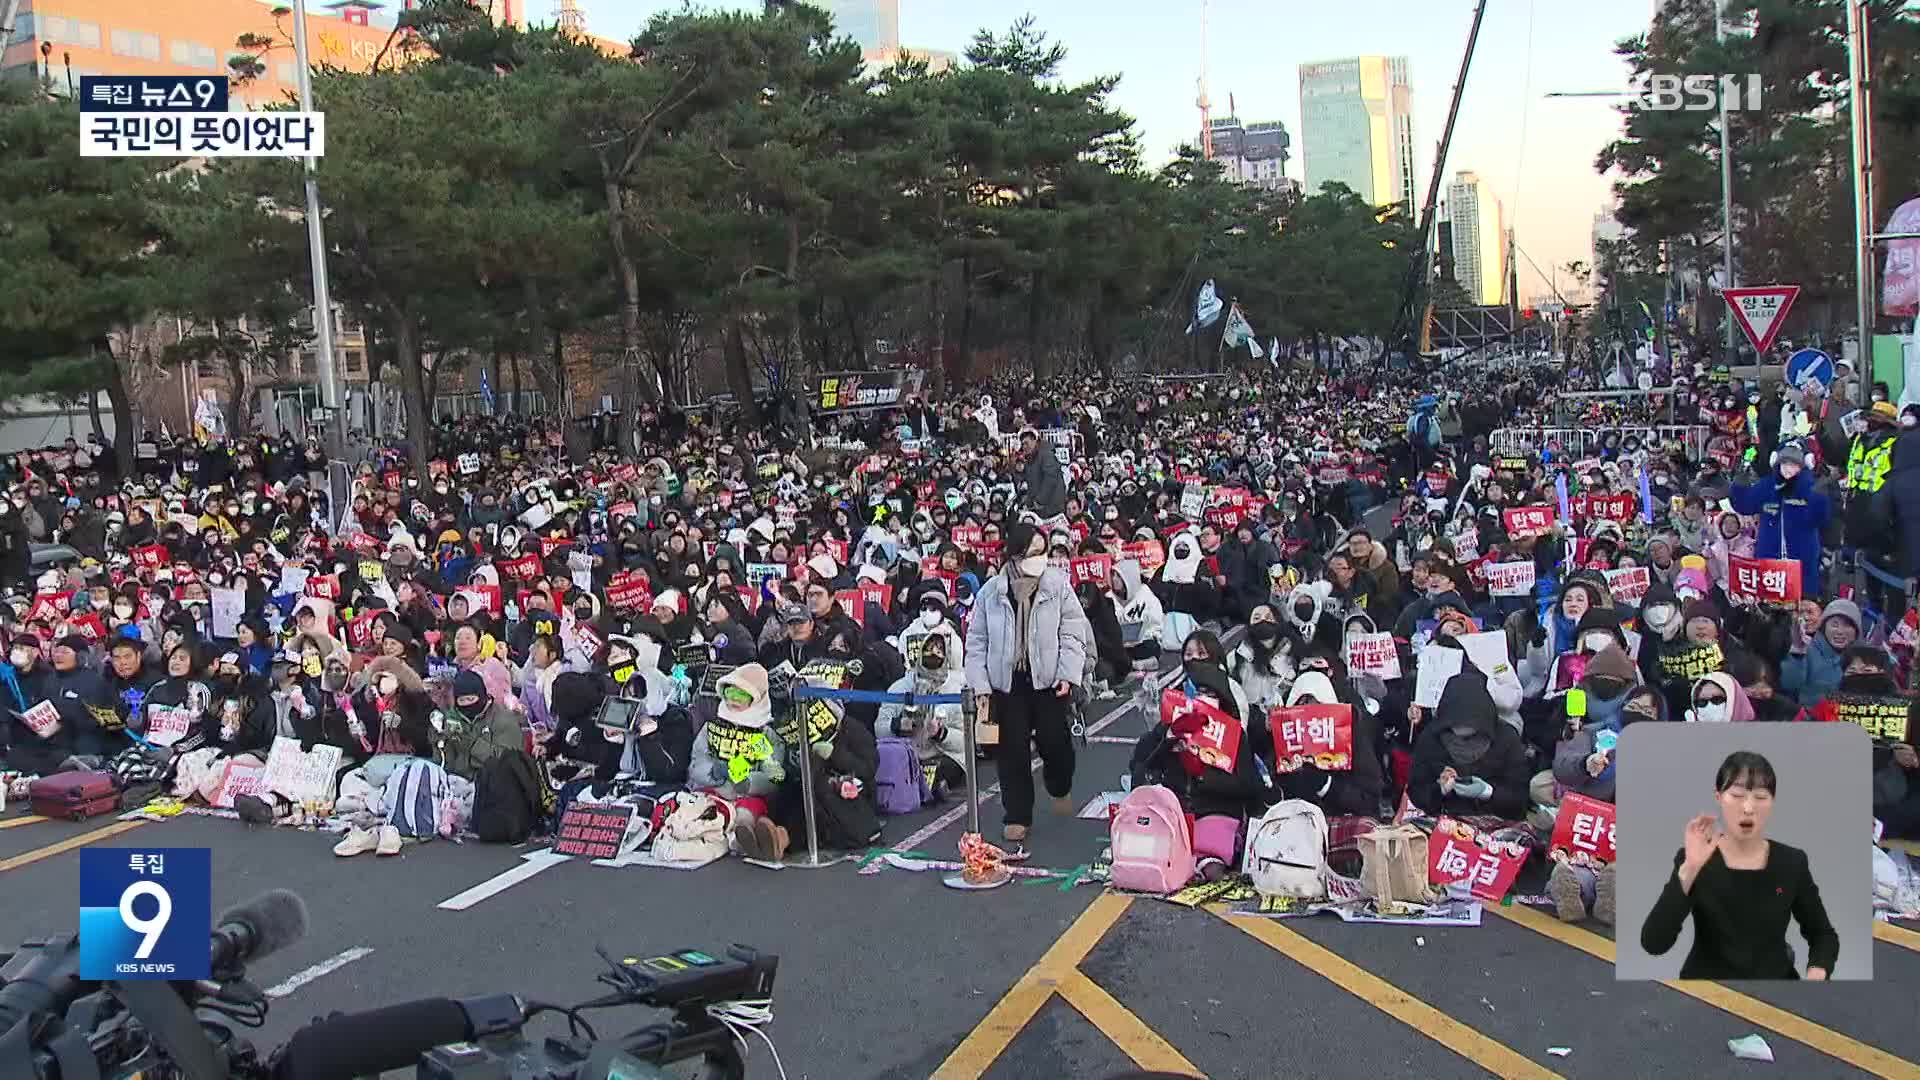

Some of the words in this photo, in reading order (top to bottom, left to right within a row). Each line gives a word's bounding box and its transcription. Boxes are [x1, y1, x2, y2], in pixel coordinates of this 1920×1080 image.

[1742, 296, 1777, 310] 양보
[1593, 500, 1625, 517] 탄핵
[1511, 511, 1546, 529] 탄핵
[1075, 559, 1105, 581] 탄핵
[1738, 567, 1788, 600] 탄핵
[1281, 715, 1336, 753] 탄핵
